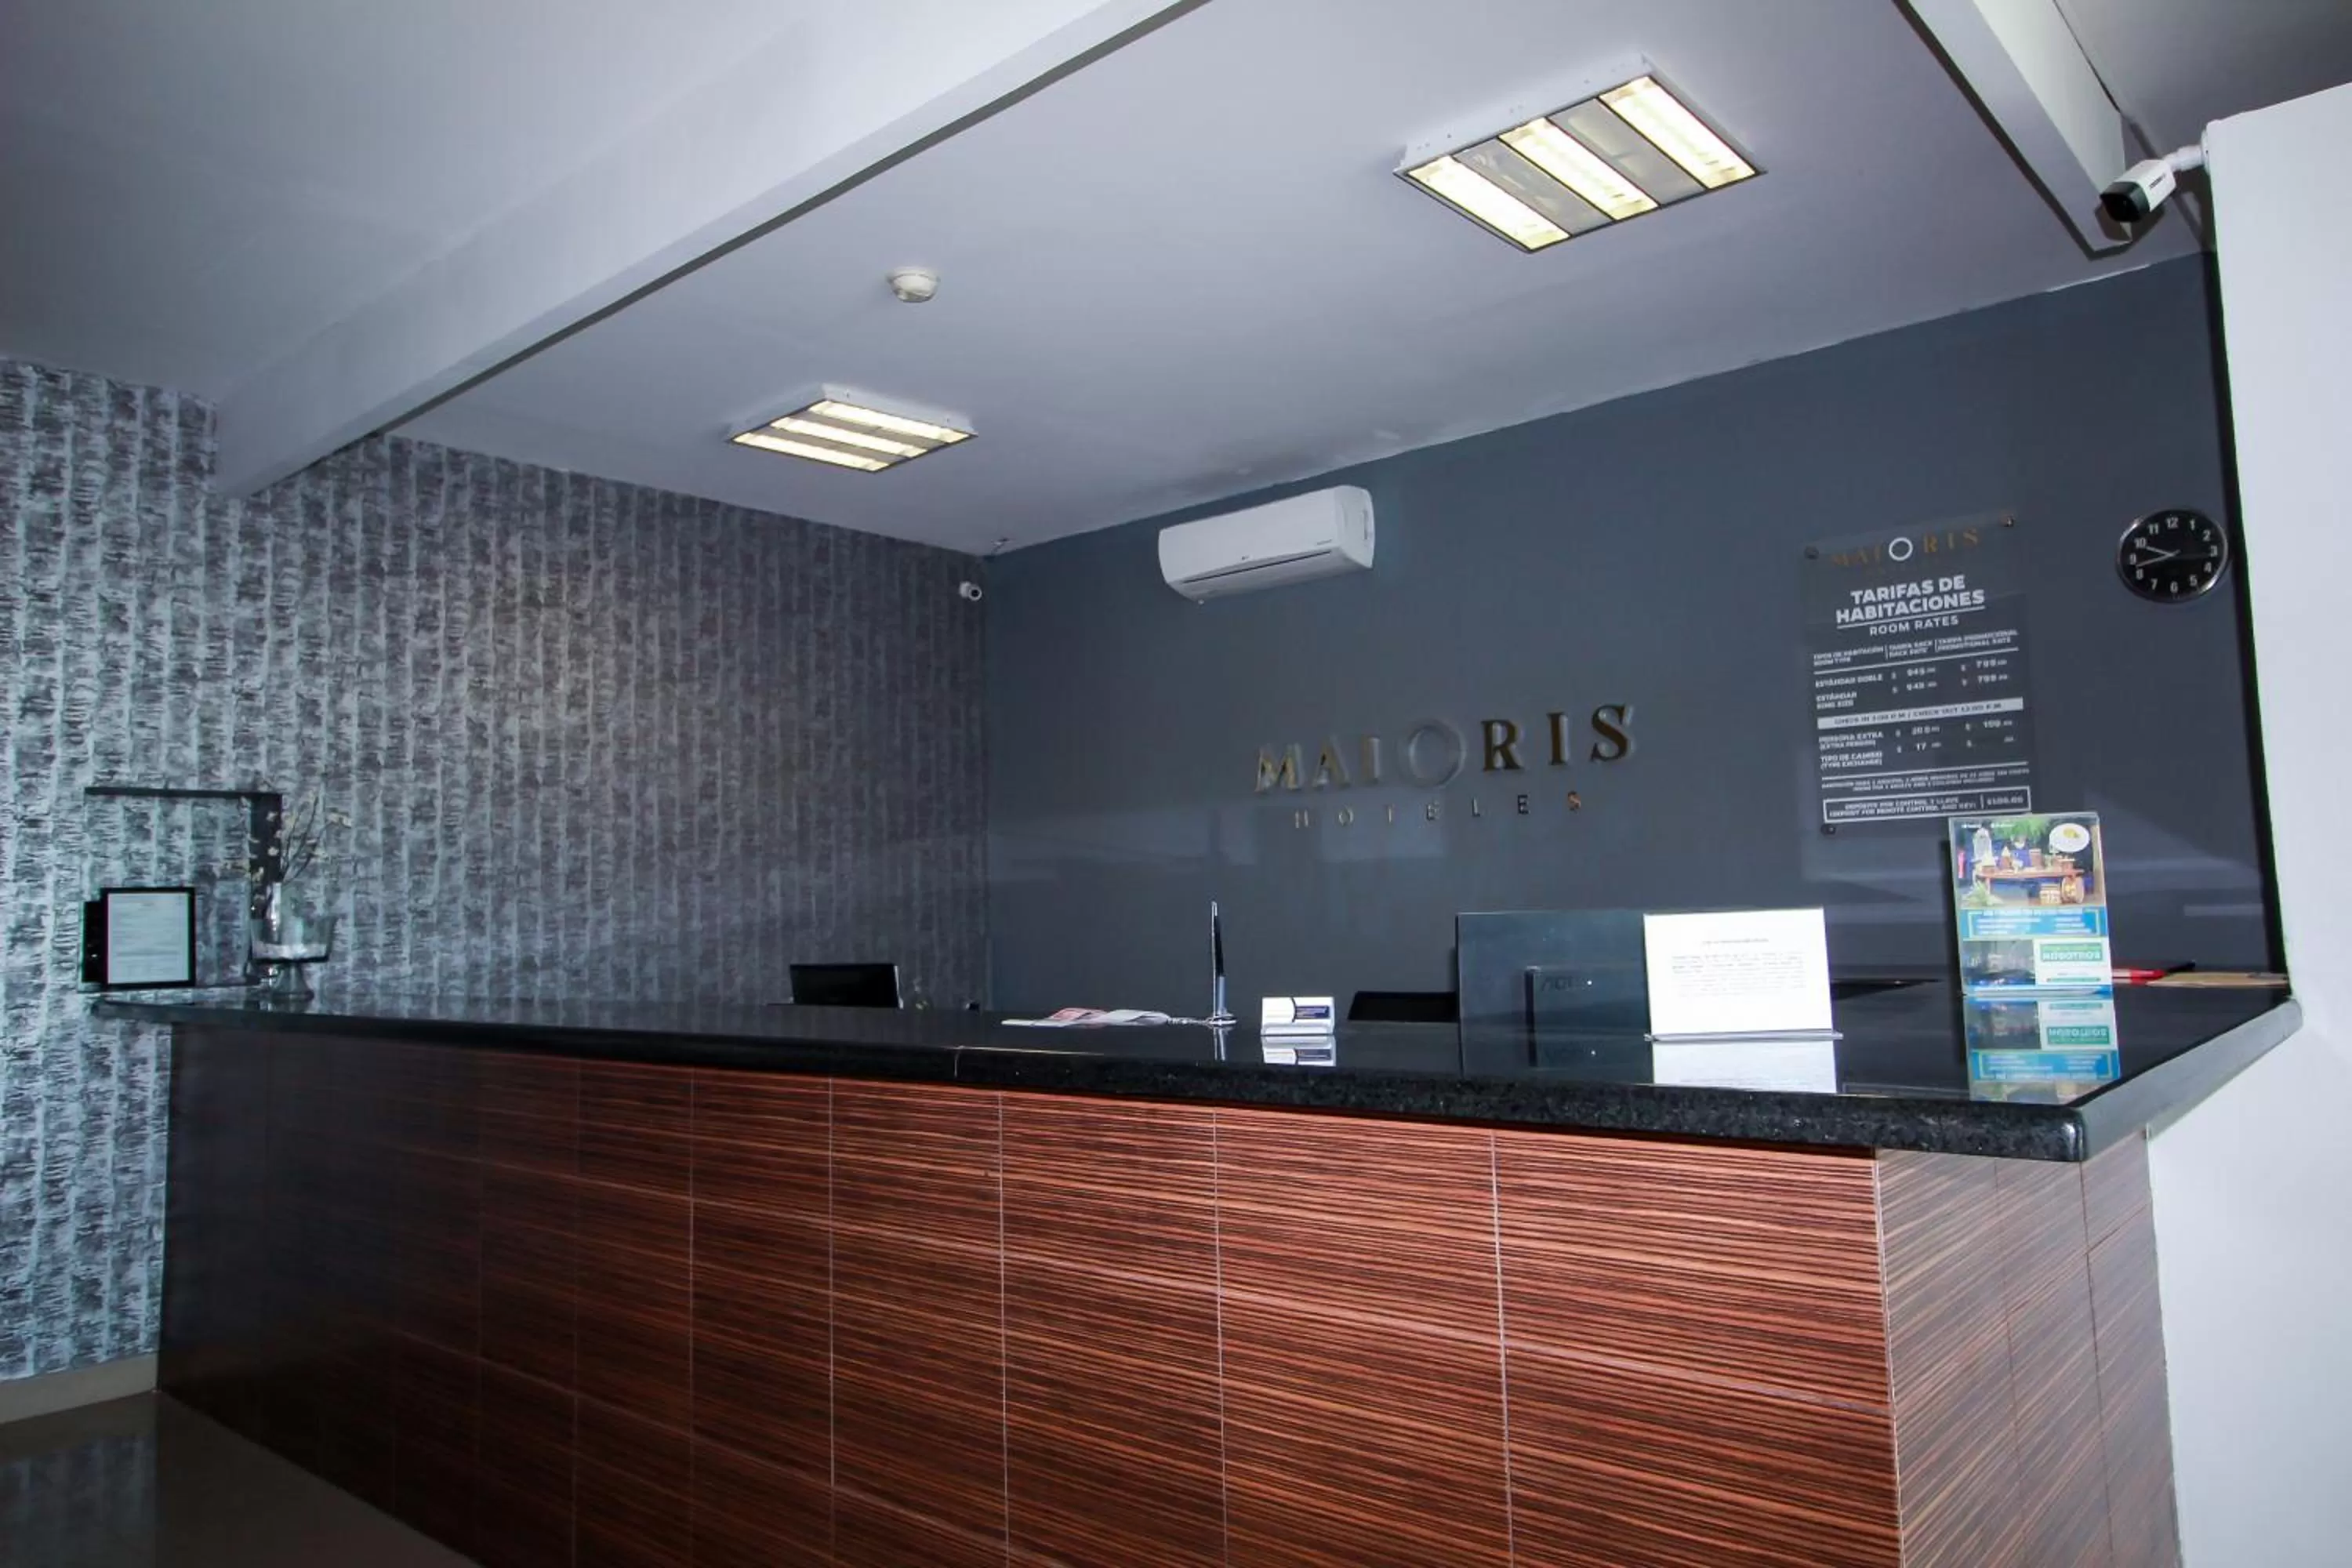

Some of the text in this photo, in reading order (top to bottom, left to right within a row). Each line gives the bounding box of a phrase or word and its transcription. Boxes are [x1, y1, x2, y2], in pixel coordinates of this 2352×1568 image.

[2148, 523, 2159, 535] 11
[2166, 517, 2179, 529] 12
[2190, 518, 2196, 531] 1
[2202, 530, 2212, 542] 2
[2135, 537, 2147, 549] 10
[2210, 545, 2218, 557] 3
[2129, 553, 2137, 565] 9
[2203, 561, 2212, 573] 4
[2151, 578, 2158, 590] 7
[2189, 574, 2198, 586] 5
[1850, 574, 1966, 605] TARIFAS DE
[1835, 590, 1985, 624] HABITACIONES
[1870, 615, 1959, 637] ROOM RATES
[1254, 704, 1634, 793] MAIORIS
[1294, 791, 1582, 829] HOTELES
